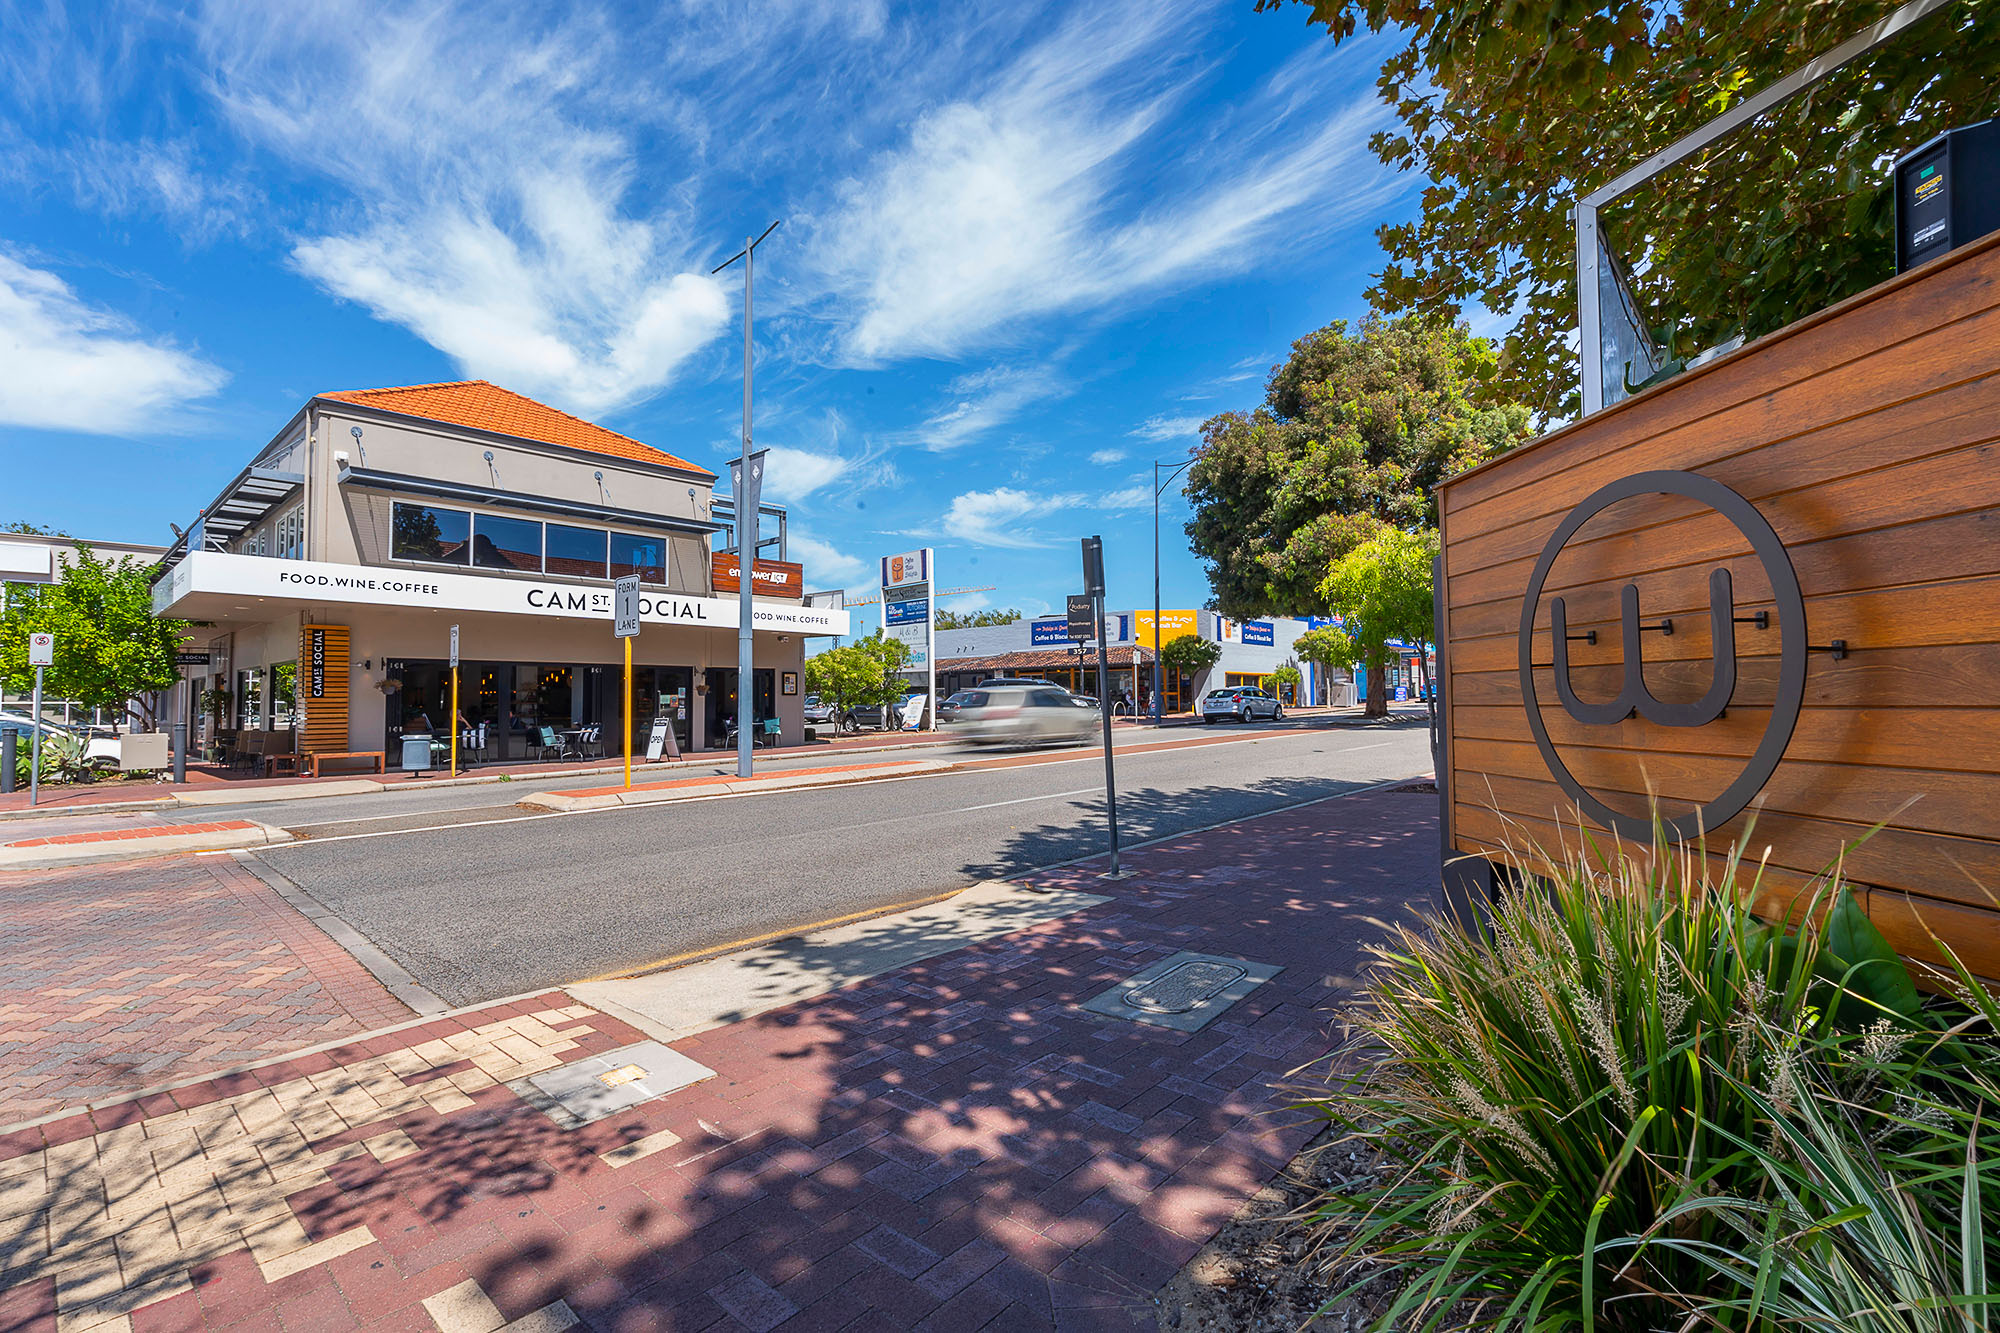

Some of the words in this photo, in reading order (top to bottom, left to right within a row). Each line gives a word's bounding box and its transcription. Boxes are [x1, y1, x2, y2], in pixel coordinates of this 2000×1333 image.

[728, 567, 771, 581] emower
[617, 582, 637, 592] FORM
[527, 589, 585, 611] CAM
[592, 594, 611, 612] ST.
[638, 598, 707, 620] OCIAL
[625, 596, 629, 615] 1
[617, 619, 636, 631] LANE
[752, 612, 829, 625] OOD.WINE.COFFEE
[314, 631, 323, 664] SOCIAL
[314, 676, 323, 697] CAM
